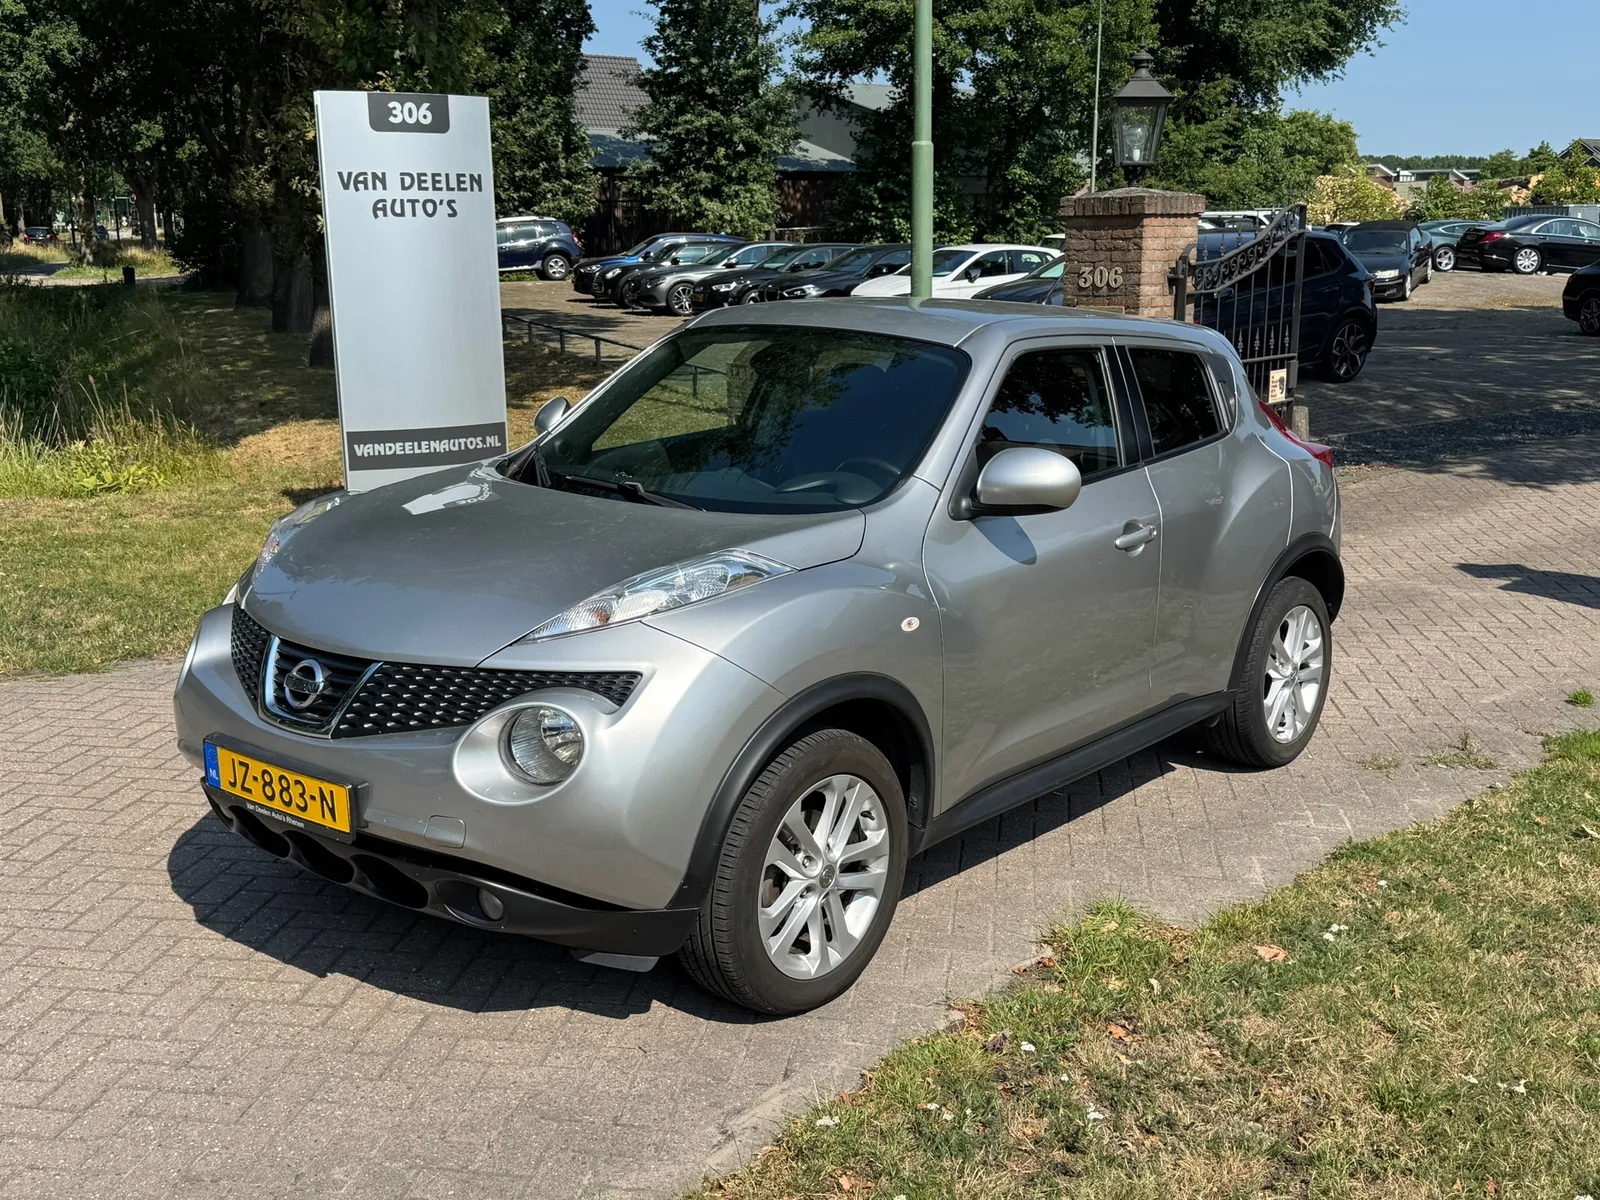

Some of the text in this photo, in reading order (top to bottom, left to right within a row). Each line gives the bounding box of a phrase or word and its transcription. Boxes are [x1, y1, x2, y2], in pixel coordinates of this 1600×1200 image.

[387, 101, 433, 125] 306
[337, 171, 483, 193] VAN DEELEN
[372, 198, 458, 220] AUTO'S
[1078, 266, 1124, 289] 306
[353, 435, 502, 458] VANDEELENAUTOS.NL
[209, 768, 219, 780] NL
[228, 757, 338, 823] JZ-883-N
[245, 801, 305, 829] Van Deelen Auto's Rhenen
